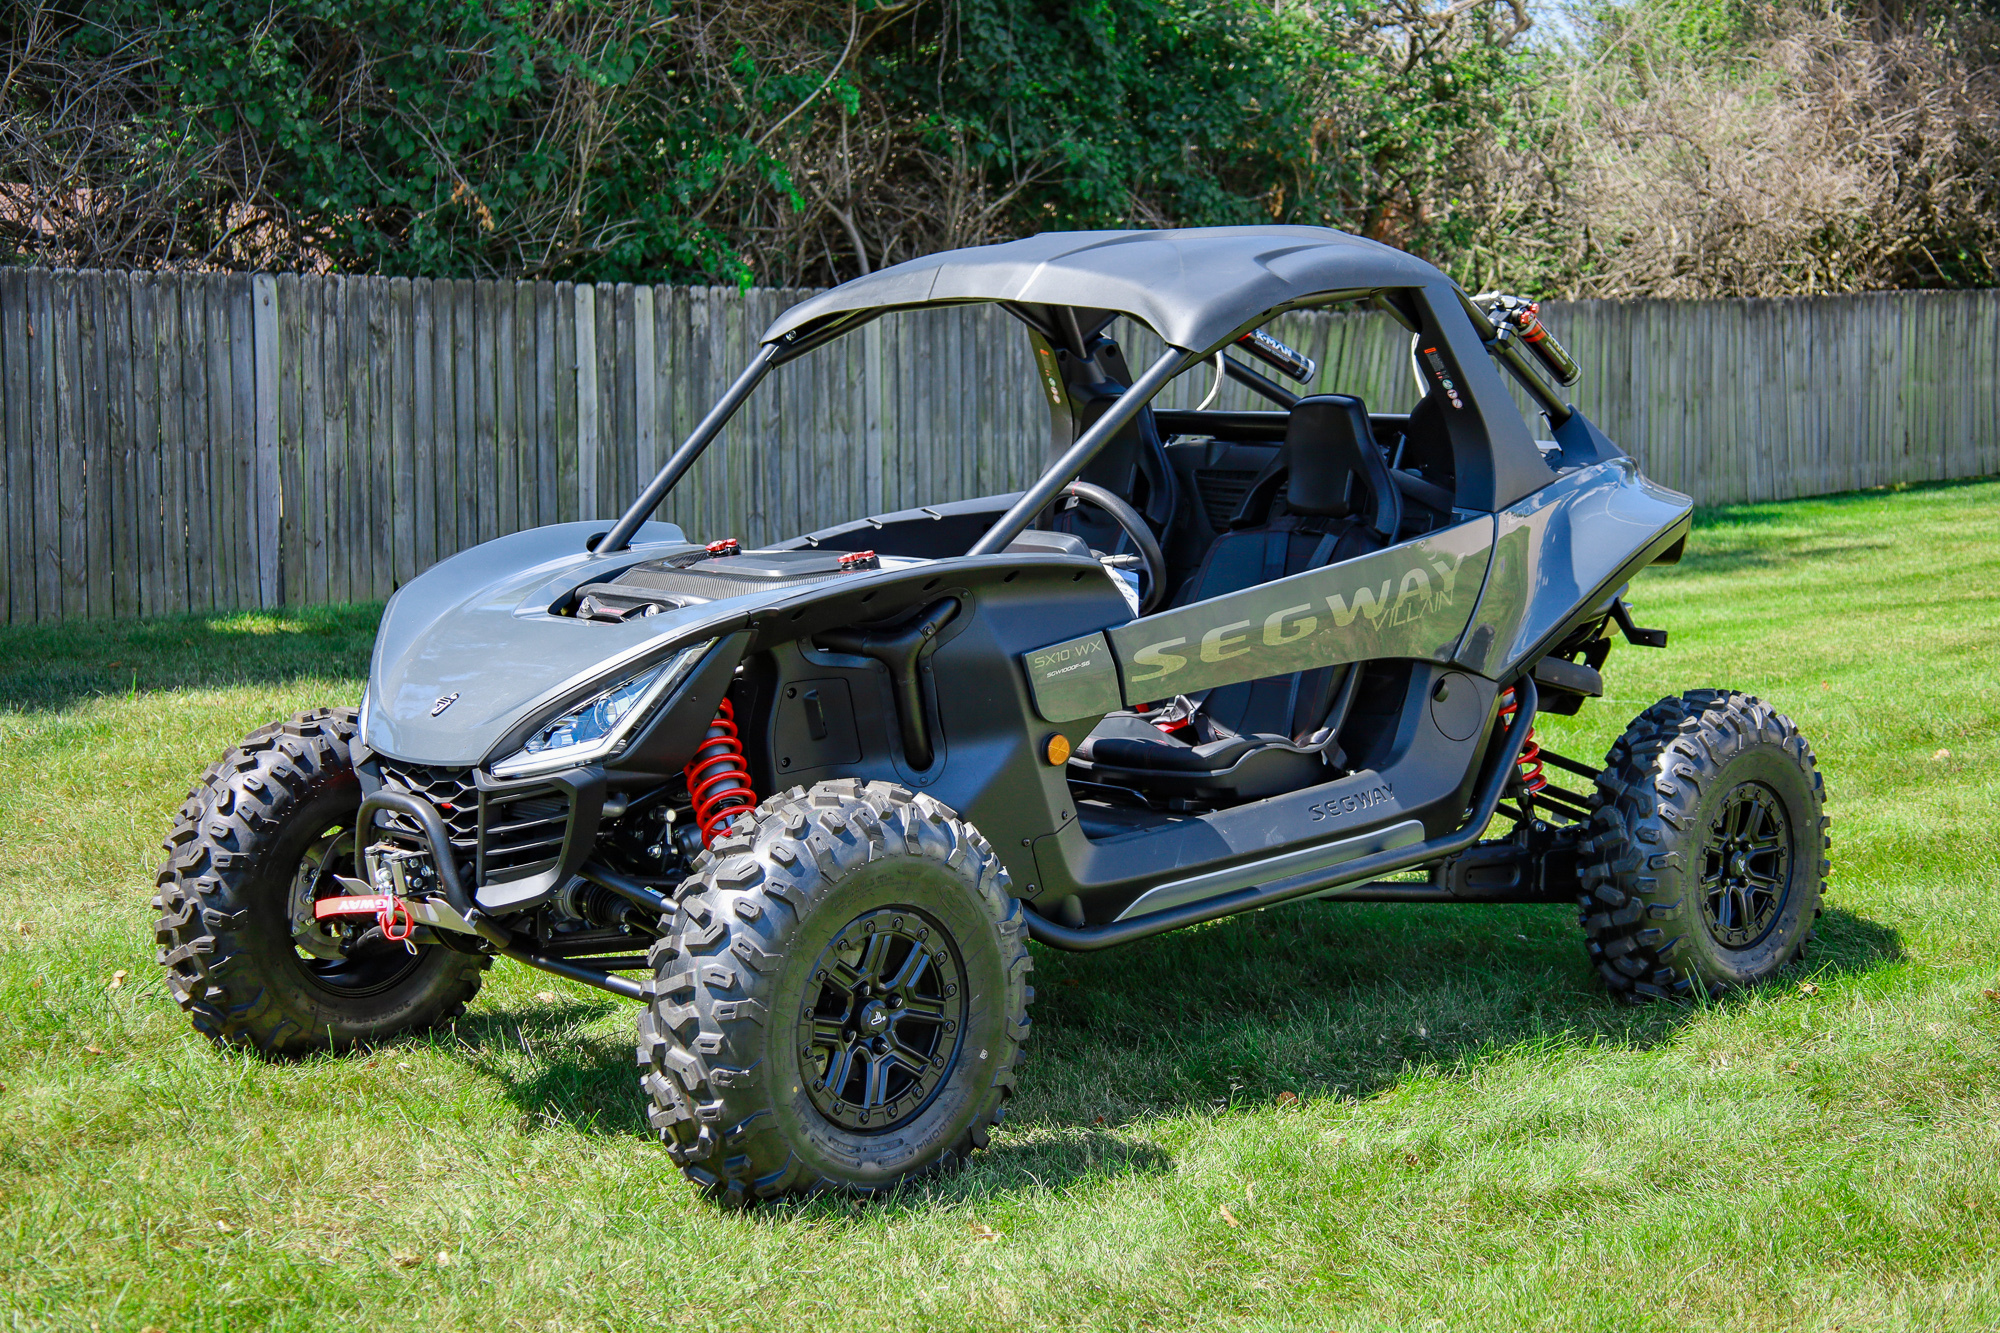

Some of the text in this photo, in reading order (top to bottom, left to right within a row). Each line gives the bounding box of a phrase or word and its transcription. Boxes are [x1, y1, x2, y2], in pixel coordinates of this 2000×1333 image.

[1255, 330, 1293, 358] K-MAN
[1131, 552, 1466, 683] SEGWAY
[1371, 588, 1454, 632] VILLAIN
[1034, 640, 1102, 669] SX10 WX
[1308, 782, 1395, 823] SEGWAY
[337, 898, 398, 912] GWAY
